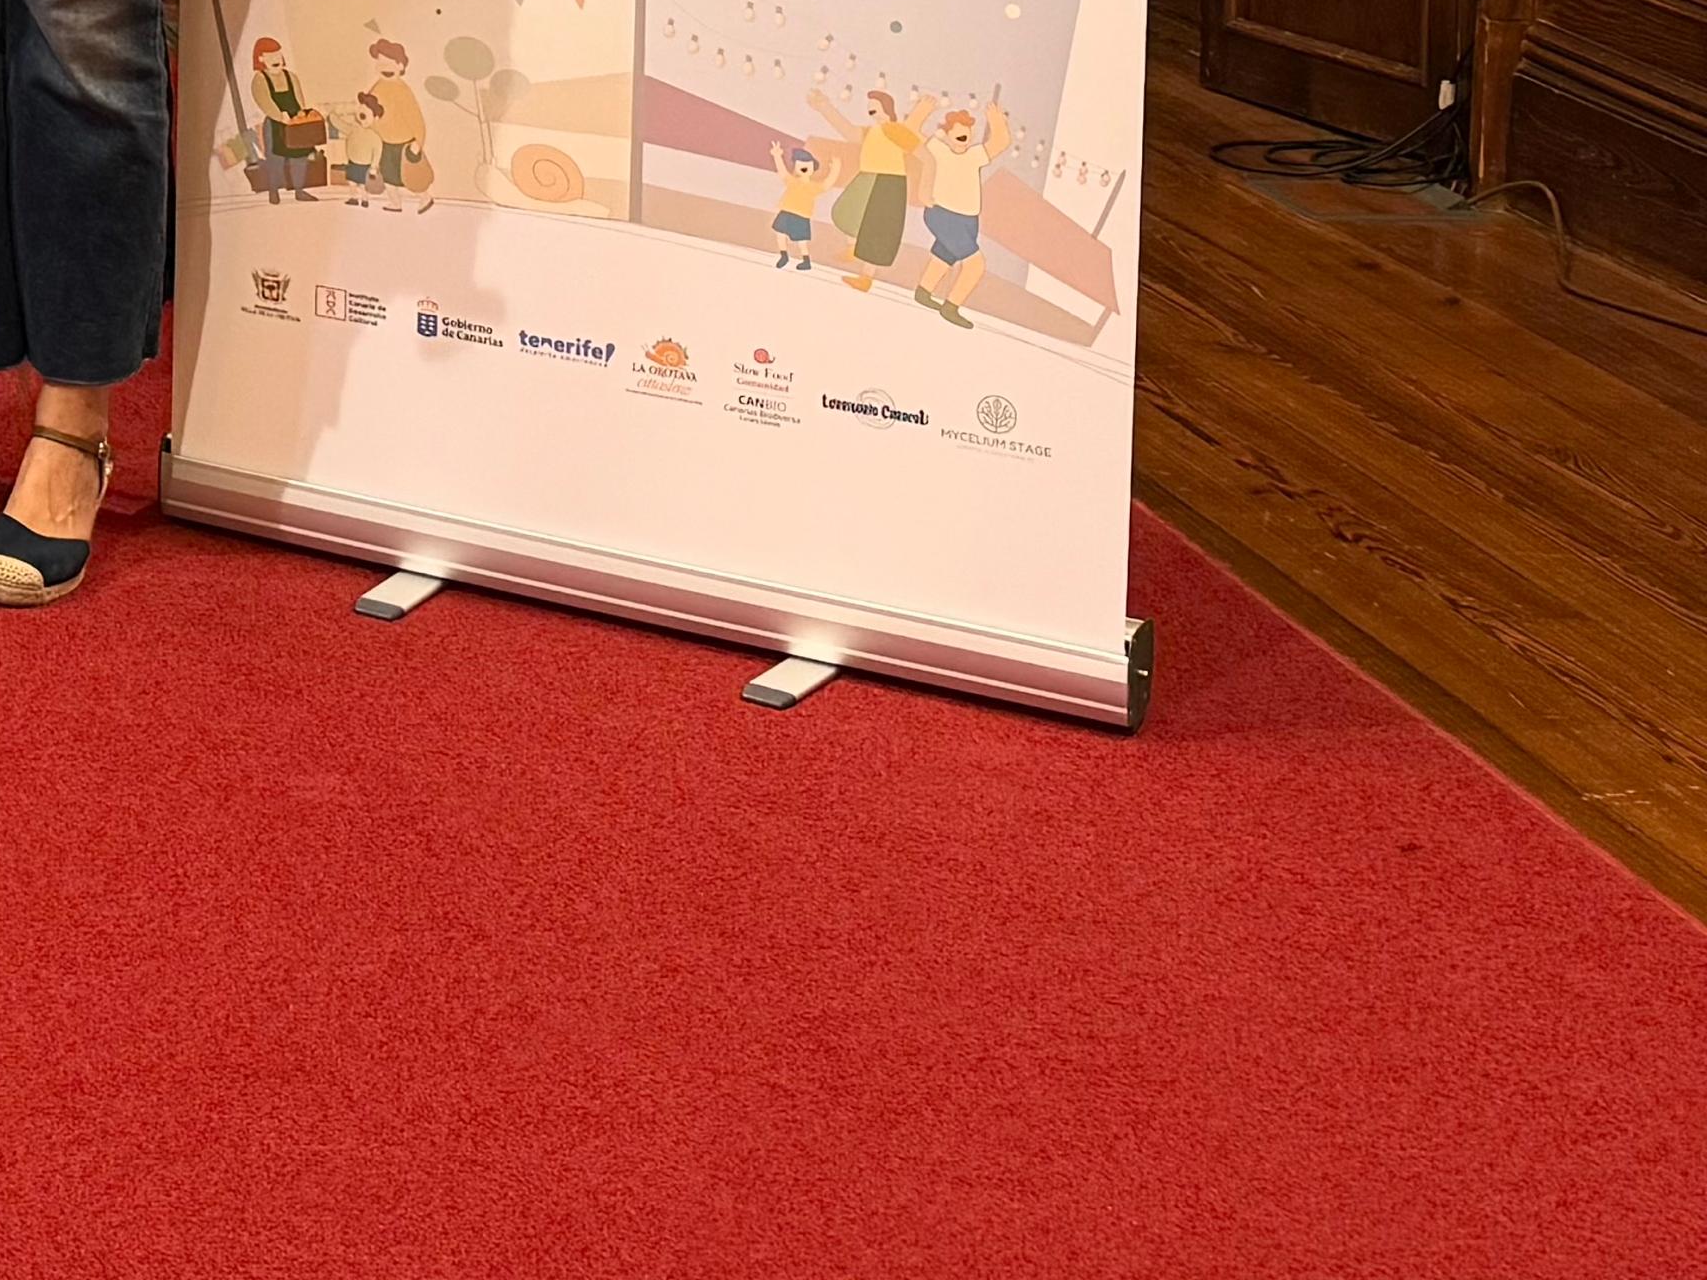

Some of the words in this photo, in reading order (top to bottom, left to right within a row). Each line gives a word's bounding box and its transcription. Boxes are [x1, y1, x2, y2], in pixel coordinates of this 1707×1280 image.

[441, 316, 492, 334] Gobierno
[441, 327, 455, 338] de
[456, 330, 504, 348] Canarias
[940, 427, 1007, 450] MYCELIUM
[1008, 440, 1052, 458] STAGE
